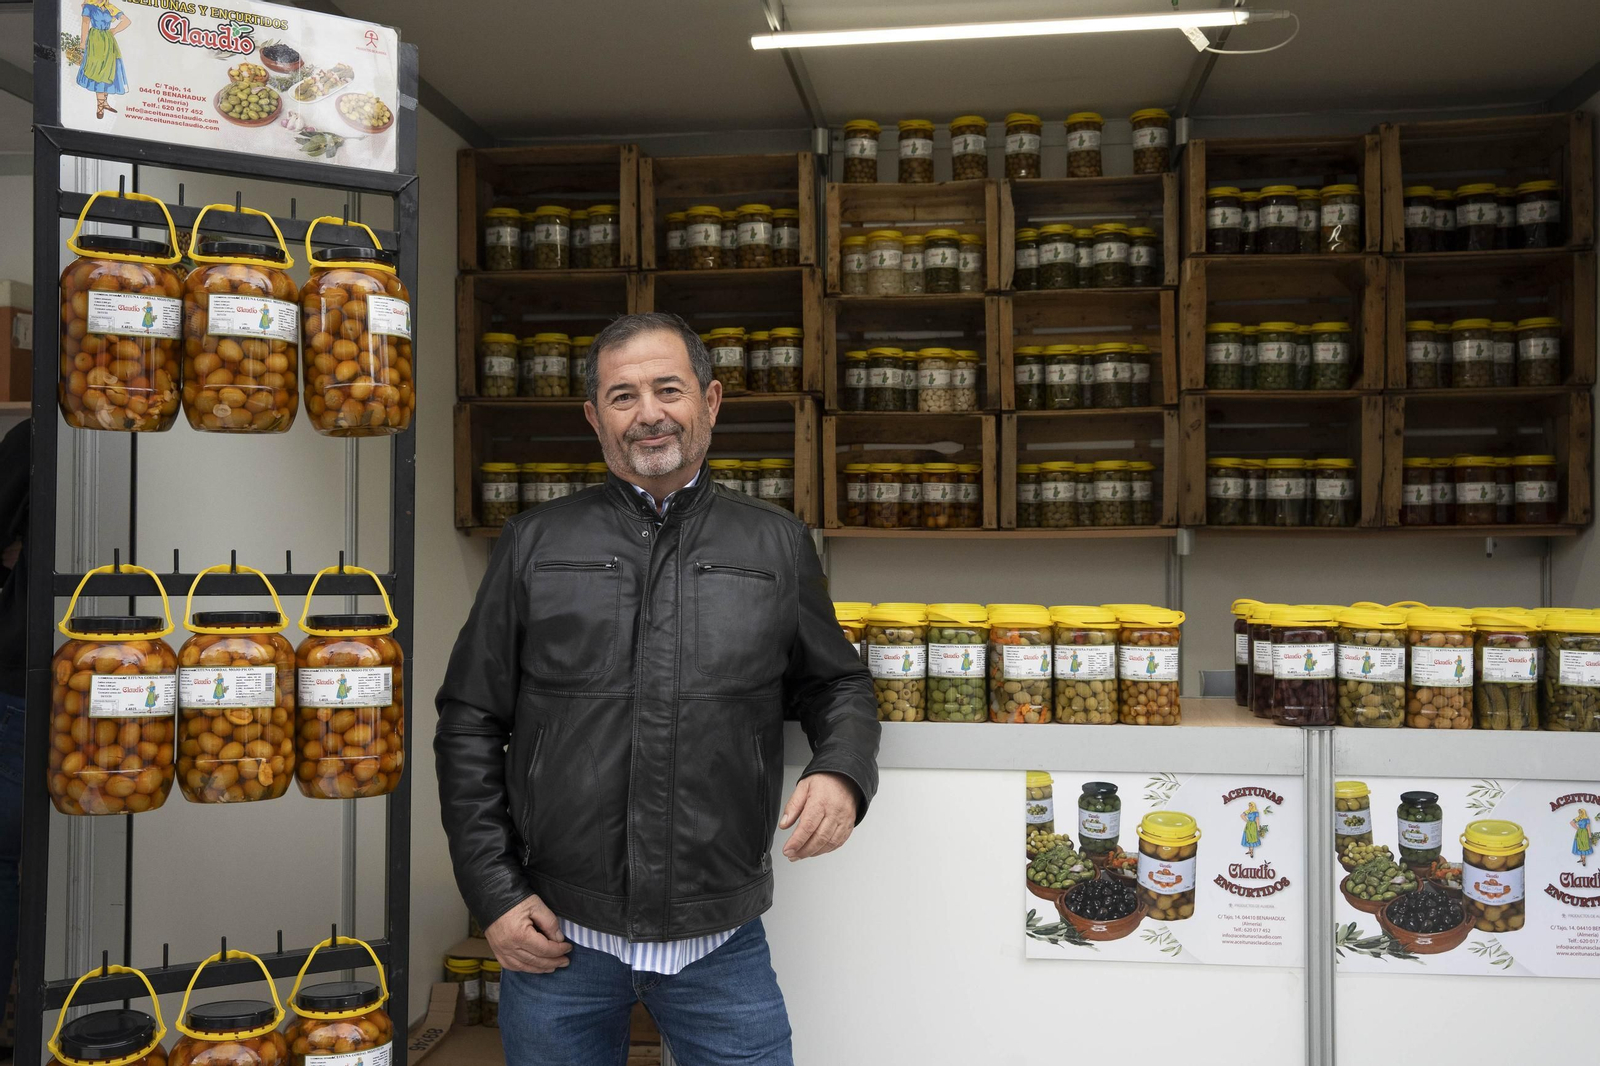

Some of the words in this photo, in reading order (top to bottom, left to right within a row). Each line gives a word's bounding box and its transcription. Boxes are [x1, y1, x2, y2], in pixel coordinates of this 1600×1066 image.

[122, 0, 196, 14] EITUNAS
[198, 5, 208, 16] Y
[210, 7, 289, 30] ENCURTIDOS
[158, 12, 255, 55] Claudio
[139, 87, 161, 95] 04410
[162, 91, 207, 102] BENAHADUX
[125, 106, 219, 124] info@aceitunasclaudio.com
[125, 113, 220, 131] www.aceitunasclaudio.com
[118, 304, 140, 312] Claudio
[236, 306, 258, 314] Claudio
[193, 677, 211, 685] Claudio
[316, 678, 335, 686] Claudio
[1222, 786, 1284, 805] ACEITUNAS
[1549, 792, 1600, 812] ACEITUN
[1228, 862, 1276, 879] Claudio
[1213, 874, 1291, 898] ENCURTIDOS
[1543, 883, 1600, 908] ENCURT
